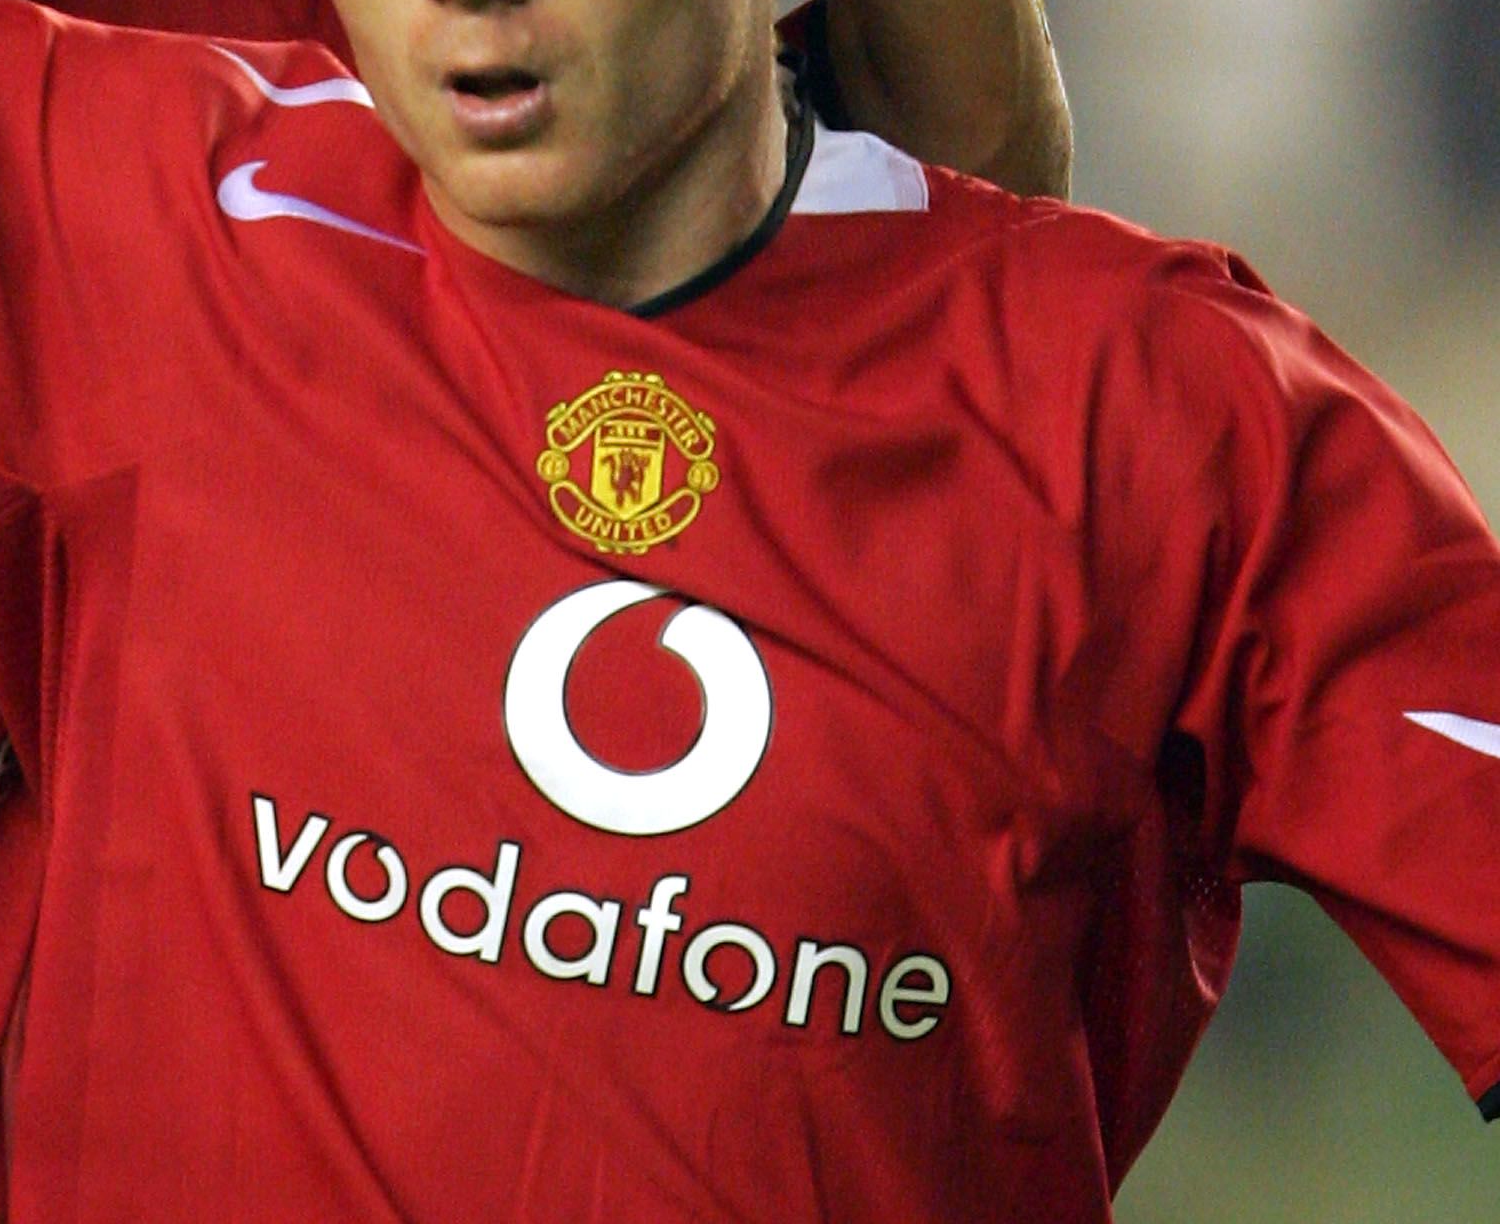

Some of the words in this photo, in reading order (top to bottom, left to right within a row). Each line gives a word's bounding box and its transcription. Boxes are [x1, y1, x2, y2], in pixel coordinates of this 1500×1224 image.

[558, 387, 700, 448] MANCHESTER
[574, 505, 672, 540] UNITED
[254, 796, 950, 1040] vodafone
